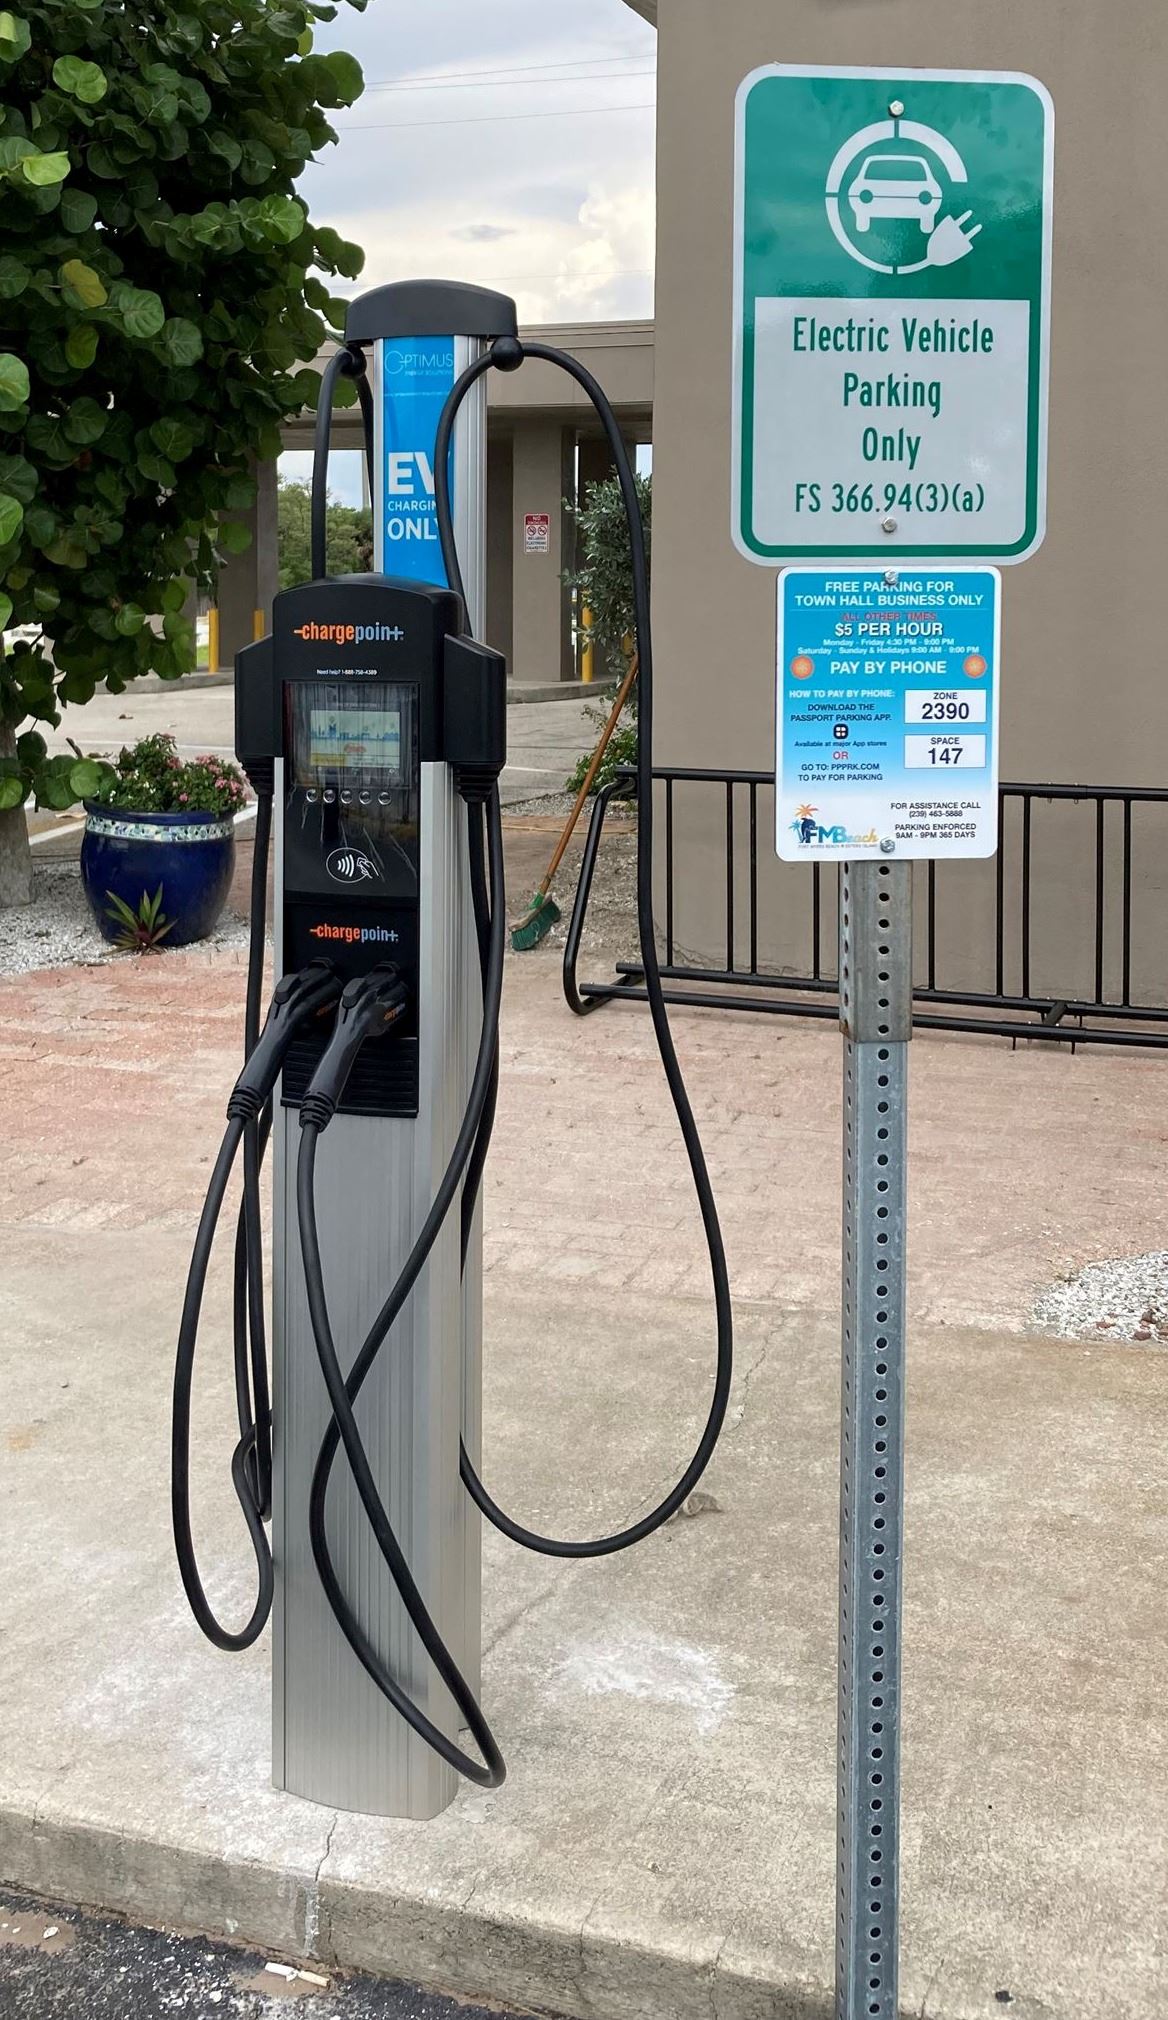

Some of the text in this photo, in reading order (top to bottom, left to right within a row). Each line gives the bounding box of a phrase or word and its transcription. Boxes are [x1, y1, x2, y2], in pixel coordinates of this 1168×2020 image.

[793, 317, 994, 354] Electric Vehicle
[843, 372, 942, 418] Parking
[861, 427, 921, 470] Only
[794, 483, 985, 515] FS 366.94(3)(a)
[387, 500, 437, 512] CHARGIN
[825, 580, 954, 593] FREE PARKING FOR
[795, 594, 984, 607] TOWN HALL BUSINESS ONLY
[834, 622, 944, 637] $5 PER HOUR
[823, 638, 854, 647] Monday
[861, 638, 885, 647] Friday
[886, 638, 903, 646] 4:30
[904, 638, 917, 646] PM
[924, 638, 940, 646] 9:00
[941, 638, 955, 646] PM
[797, 646, 832, 655] Saturday
[839, 646, 867, 655] Sunday
[877, 646, 910, 655] Holidays
[911, 646, 928, 654] 9:00
[928, 646, 943, 654] AM
[948, 645, 965, 654] 9:00
[966, 646, 980, 654] PM
[830, 660, 947, 675] PAY BY PHONE
[788, 689, 895, 699] HOW TO PAY BY PHONE:
[933, 692, 958, 700] ZONE
[808, 703, 876, 711] DOWNLOAD THE
[921, 702, 970, 720] 2390
[790, 714, 834, 722] PASSPORT
[852, 740, 866, 748] App
[930, 737, 960, 745] SPACE
[832, 751, 849, 760] OR
[927, 747, 963, 765] 147
[801, 763, 880, 771] GO TO: PPPRK.COM
[798, 773, 809, 781] TO
[828, 773, 845, 781] FOR
[847, 773, 884, 781] PARKING
[890, 801, 982, 810] FOR ASSISTANCE CALL
[909, 810, 927, 818] (239)
[895, 823, 977, 831] PARKING ENFORCED
[954, 830, 976, 838] DAYS
